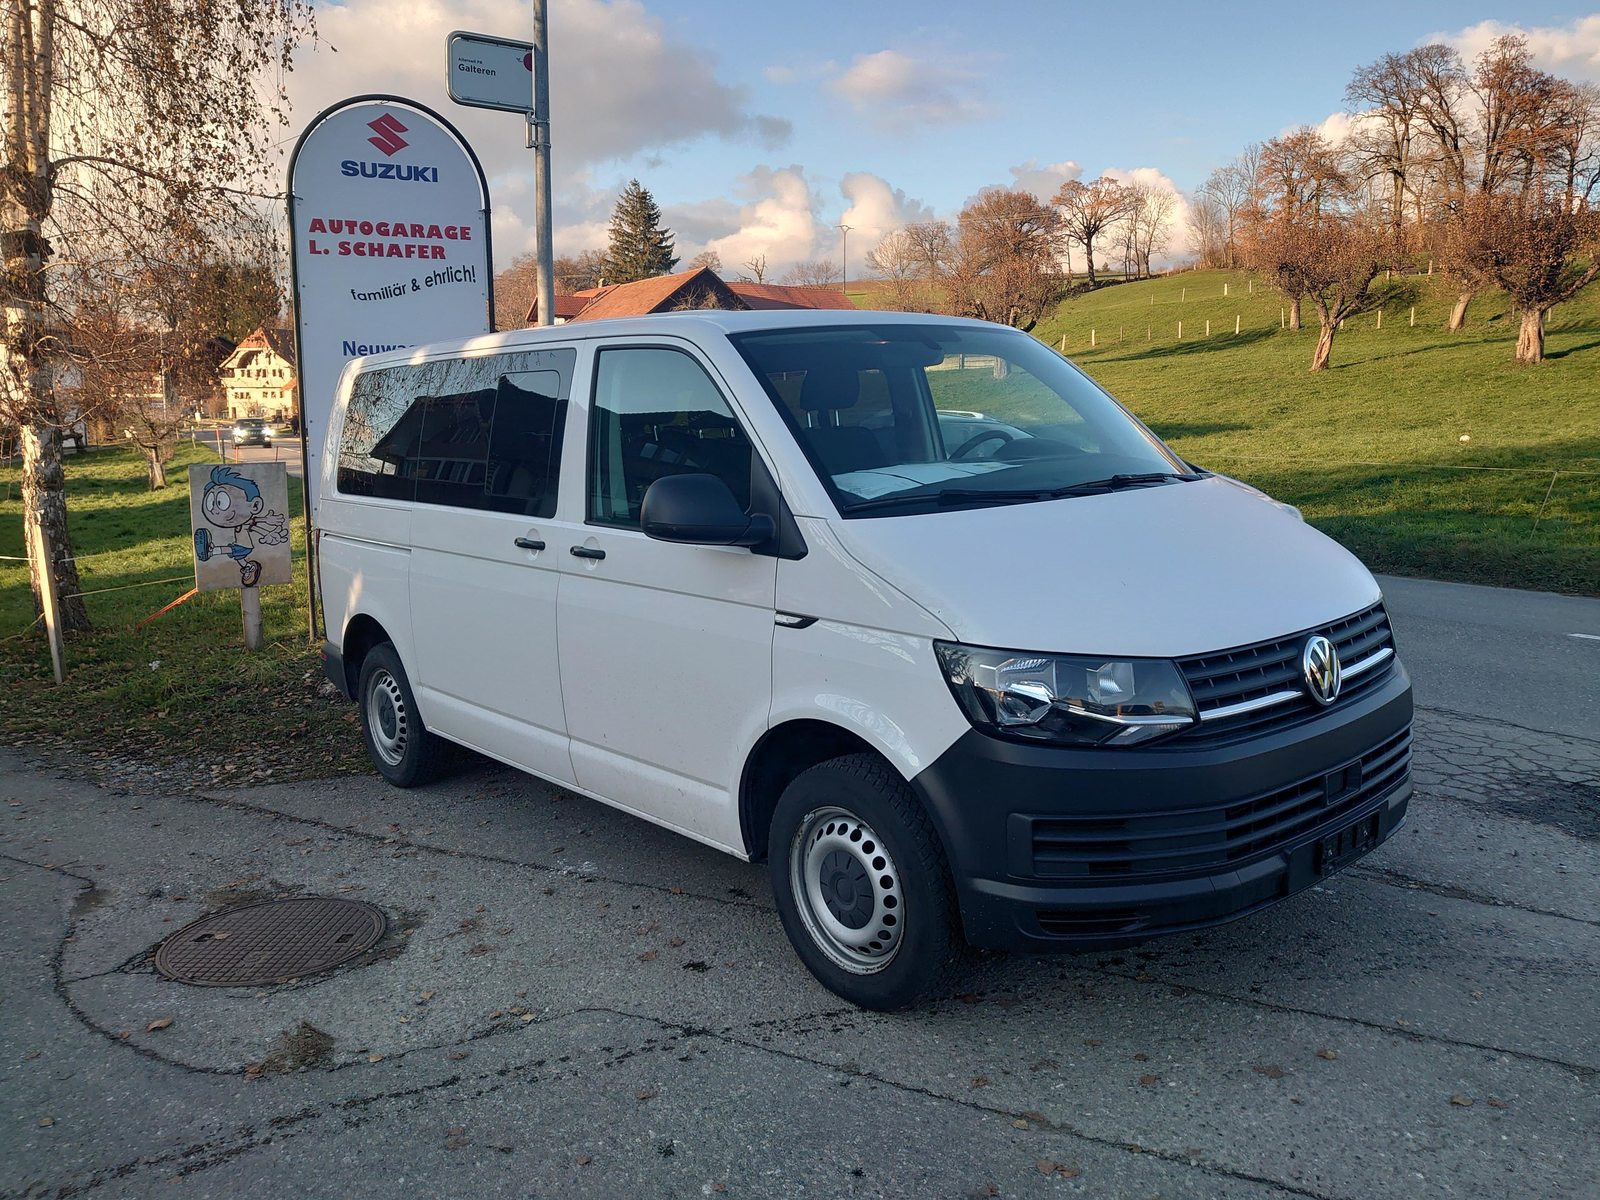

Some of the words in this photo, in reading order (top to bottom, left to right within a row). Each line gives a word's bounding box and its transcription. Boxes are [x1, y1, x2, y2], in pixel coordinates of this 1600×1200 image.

[458, 63, 496, 76] Galteren
[341, 160, 438, 183] SUZUKI
[309, 218, 471, 241] AUTOGARAGE
[309, 240, 330, 255] L.
[338, 241, 446, 260] SCHAFER
[351, 283, 406, 301] familiär
[411, 278, 421, 292] &
[425, 265, 476, 283] ehrlich!
[343, 340, 416, 356] Neuw
